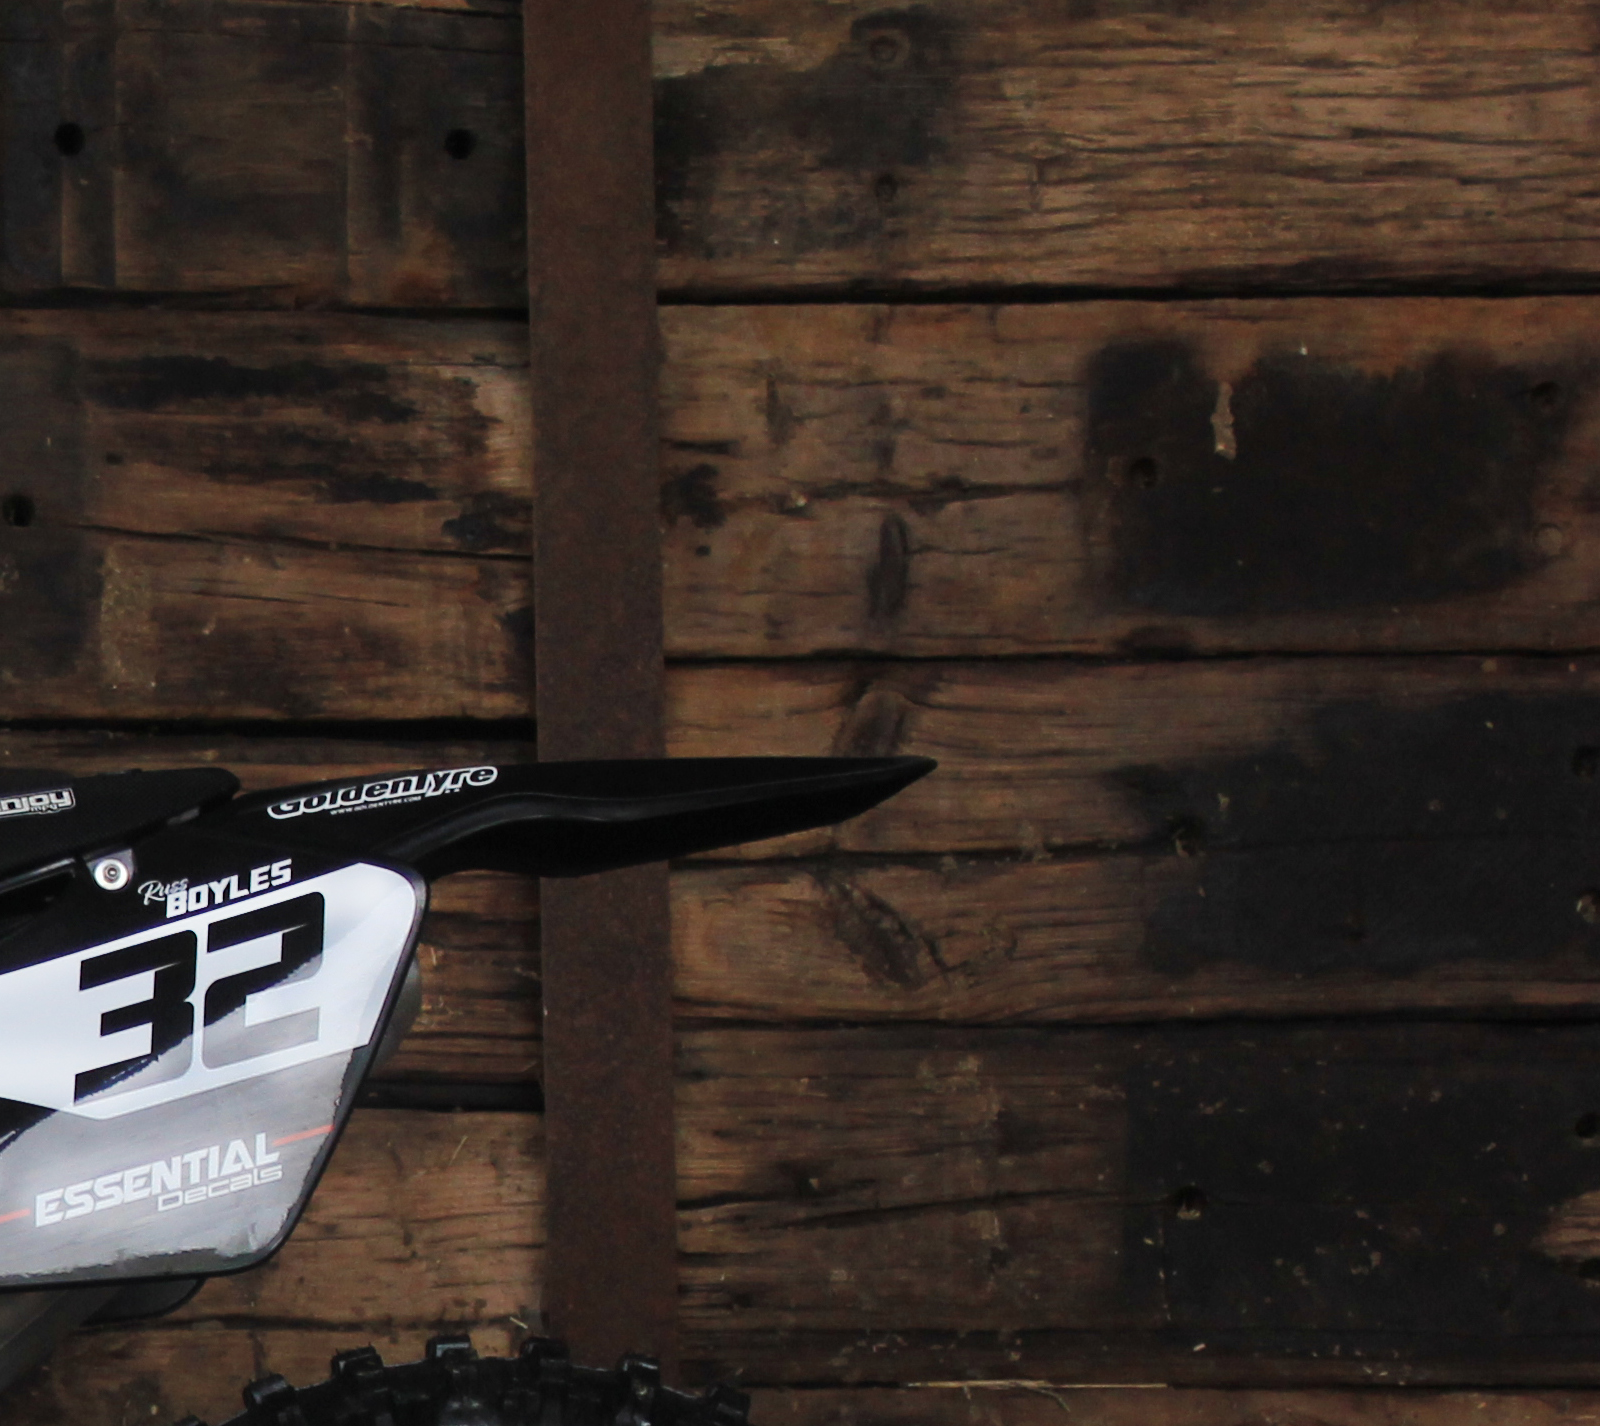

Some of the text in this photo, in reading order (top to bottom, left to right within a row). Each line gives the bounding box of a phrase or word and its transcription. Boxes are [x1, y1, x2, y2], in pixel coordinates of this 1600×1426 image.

[166, 858, 293, 919] BOYLES
[73, 891, 326, 1106] 32
[33, 1132, 282, 1228] ESSENTIAL
[157, 1164, 283, 1211] Decals
